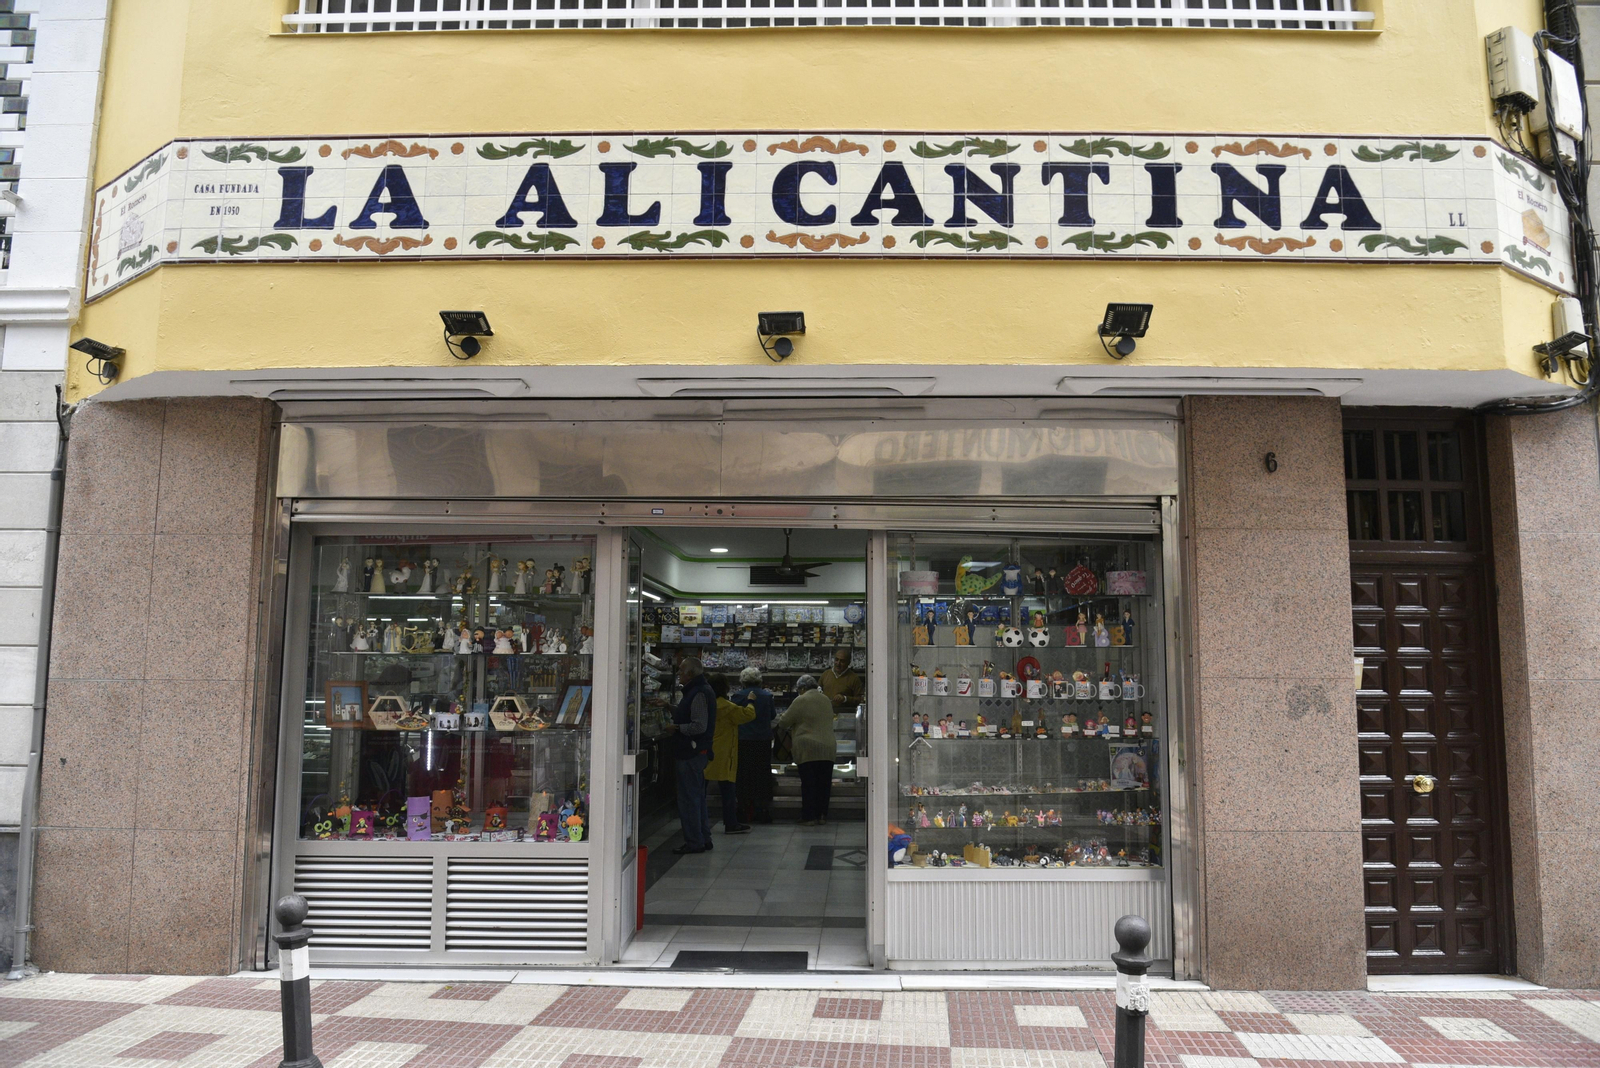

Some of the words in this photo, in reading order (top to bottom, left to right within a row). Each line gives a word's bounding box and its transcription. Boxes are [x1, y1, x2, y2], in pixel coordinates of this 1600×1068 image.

[194, 184, 216, 194] CASA
[219, 183, 260, 194] FUNDADA
[272, 164, 430, 230] LA
[494, 160, 1383, 231] ALICANTINA
[209, 206, 221, 216] EN
[223, 206, 240, 216] 1950
[1517, 189, 1525, 200] El
[1526, 194, 1548, 213] Romero
[912, 626, 929, 646] 18
[952, 626, 970, 646] 18
[1063, 625, 1081, 646] 18
